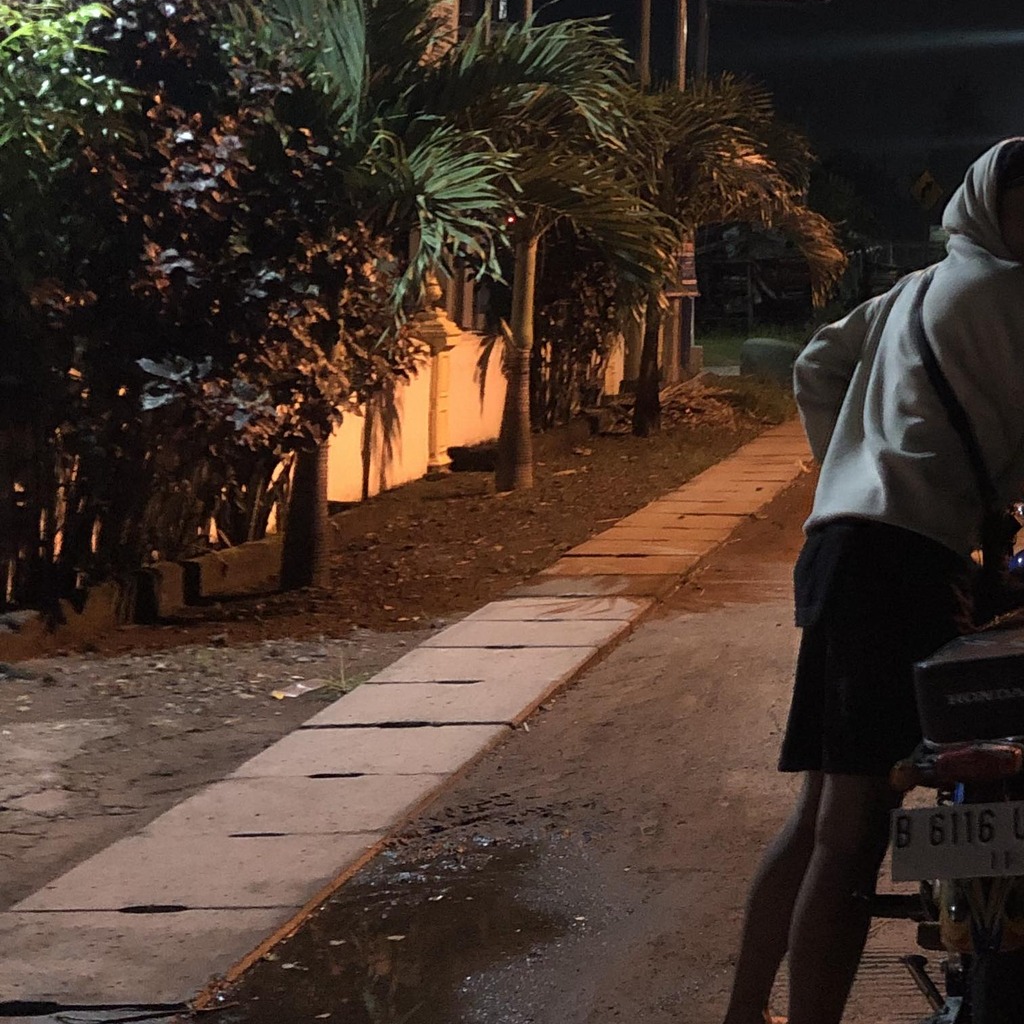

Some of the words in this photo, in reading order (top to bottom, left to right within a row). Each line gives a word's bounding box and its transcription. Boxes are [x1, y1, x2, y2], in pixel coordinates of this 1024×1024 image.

[947, 687, 1023, 705] HONDA
[896, 814, 911, 848] B
[930, 808, 996, 846] 6116
